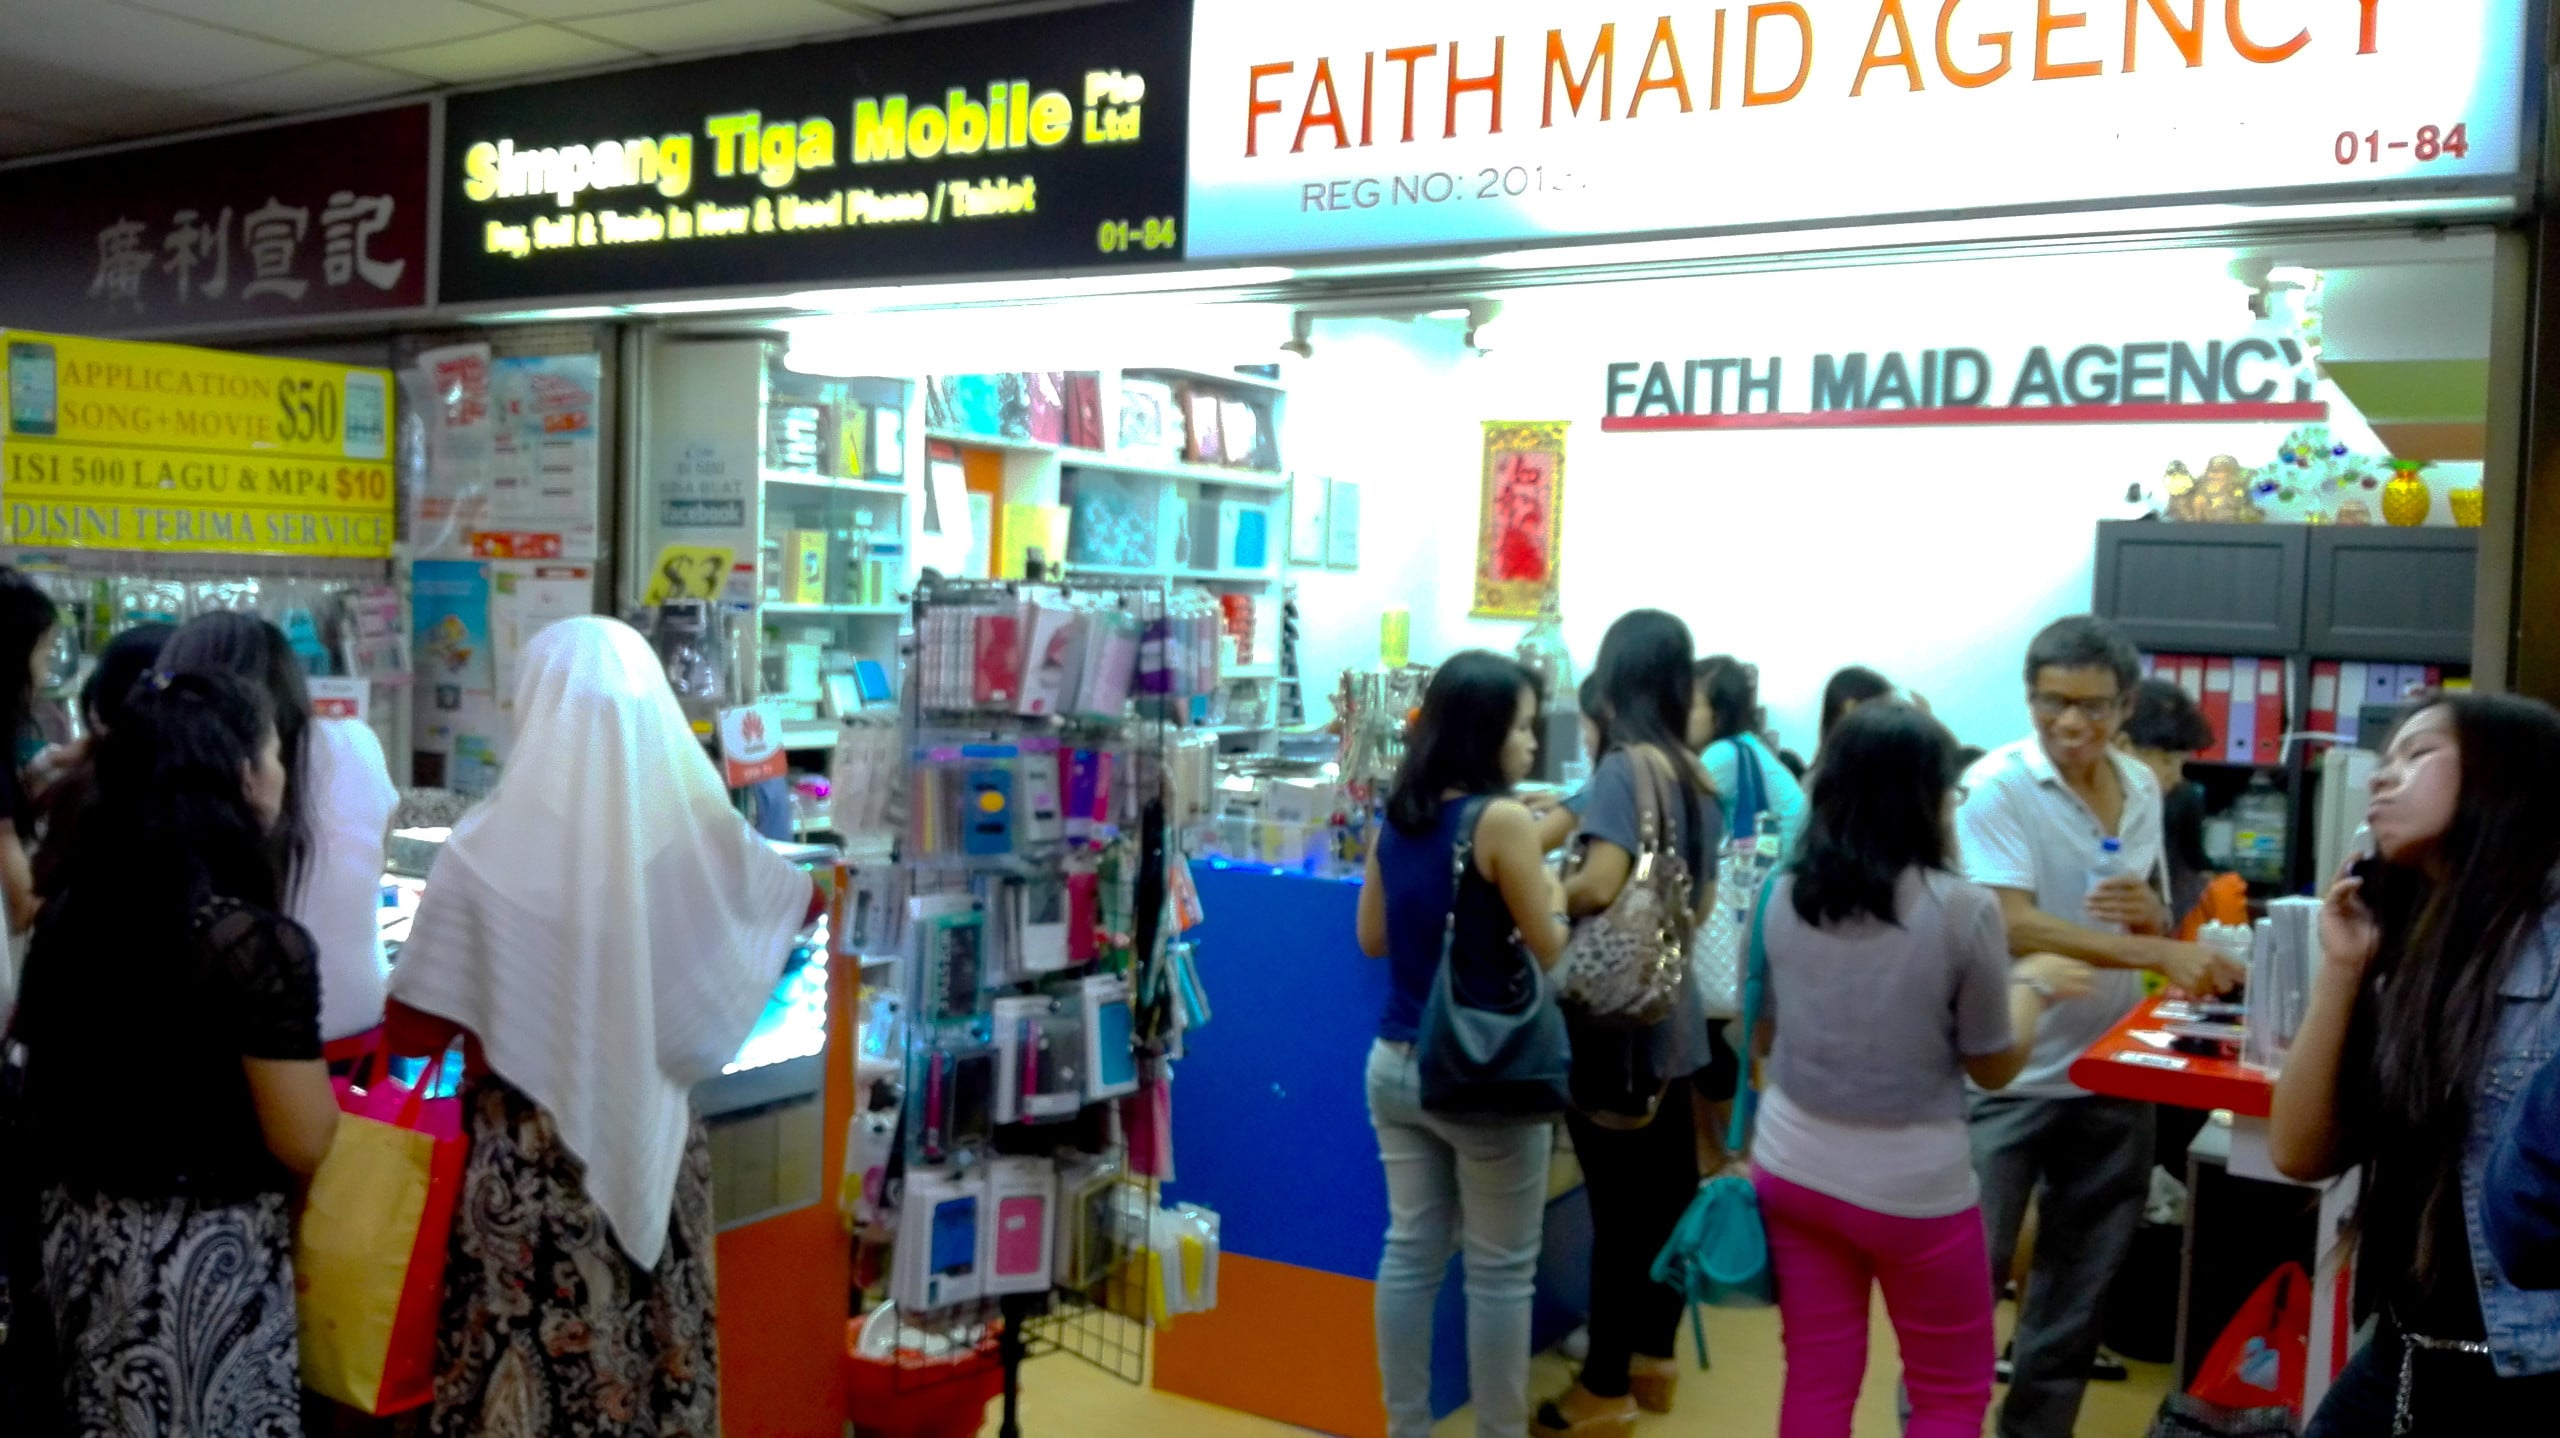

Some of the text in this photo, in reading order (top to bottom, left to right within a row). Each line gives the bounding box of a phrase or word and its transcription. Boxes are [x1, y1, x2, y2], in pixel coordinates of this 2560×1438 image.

[1085, 70, 1146, 107] Pte
[1244, 36, 1504, 157] FAITH
[1540, 1, 1813, 128] MAID
[465, 81, 1072, 206] Simpang Tiga Mobile
[1083, 104, 1141, 144] Ltd
[2334, 122, 2469, 165] 01-84
[577, 211, 598, 247] &
[695, 200, 750, 237] New
[752, 196, 775, 233] &
[778, 191, 843, 231] Used
[846, 187, 929, 226] Phone
[948, 174, 1036, 218] Tablet
[1301, 177, 1381, 213] REG
[1392, 171, 1463, 206] NO:
[1097, 217, 1176, 253] 01-84
[61, 359, 272, 400] APPLICATION
[1606, 337, 2312, 417] FAITH MAID AGENCY
[61, 400, 272, 441] SONG+MOVIE
[277, 375, 338, 445] $50
[12, 453, 386, 500] ISI 500 LAGU & MP4 $10
[11, 502, 387, 548] DISINI TERIMA SERVICE
[662, 501, 739, 523] facebook
